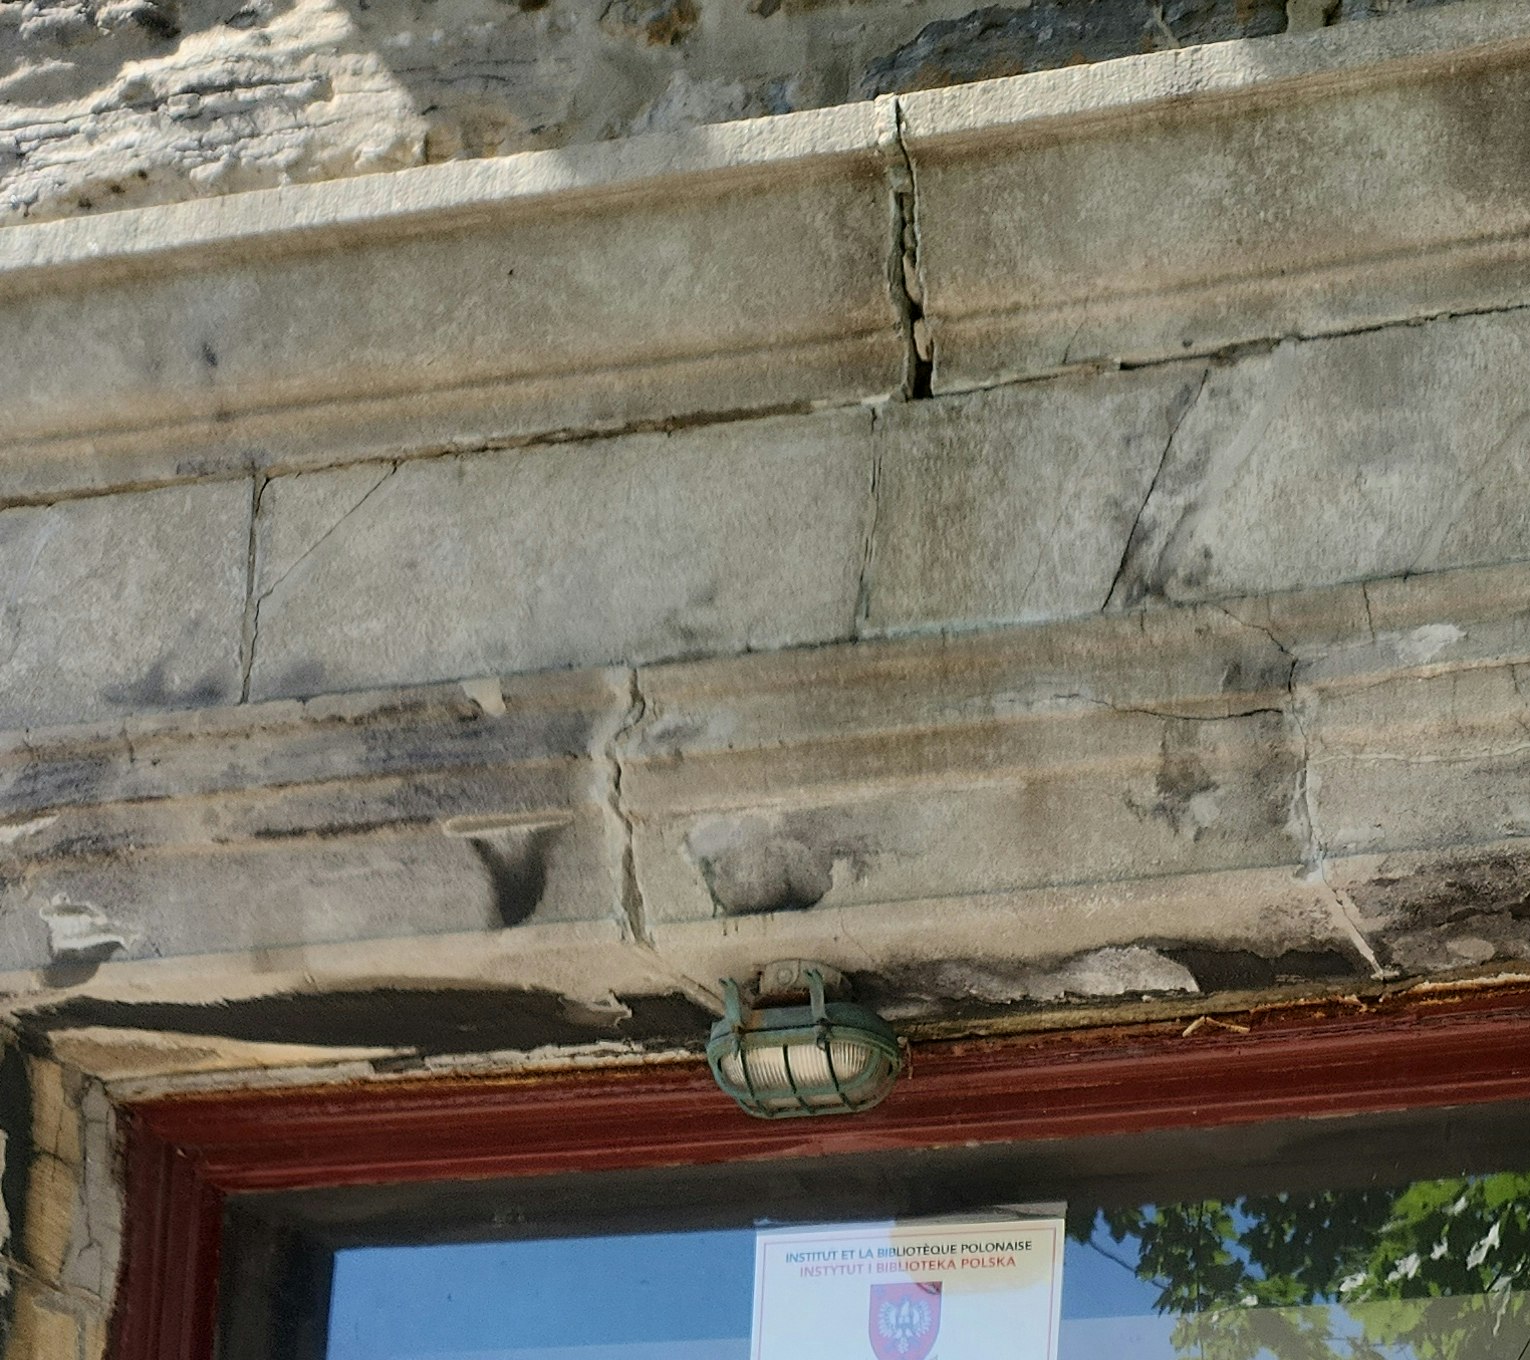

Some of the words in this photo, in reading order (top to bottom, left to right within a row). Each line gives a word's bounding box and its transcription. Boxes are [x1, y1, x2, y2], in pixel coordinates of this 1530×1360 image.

[786, 1251, 837, 1263] INSTITUT
[841, 1250, 855, 1260] ET
[859, 1248, 874, 1259] LA
[877, 1243, 957, 1258] BIBLIOTÈQUE
[961, 1241, 1032, 1253] POLONAISE
[800, 1263, 864, 1277] INSTYTUT
[877, 1259, 957, 1274] BIBLIOTEKA
[961, 1256, 1016, 1269] POLSKA
